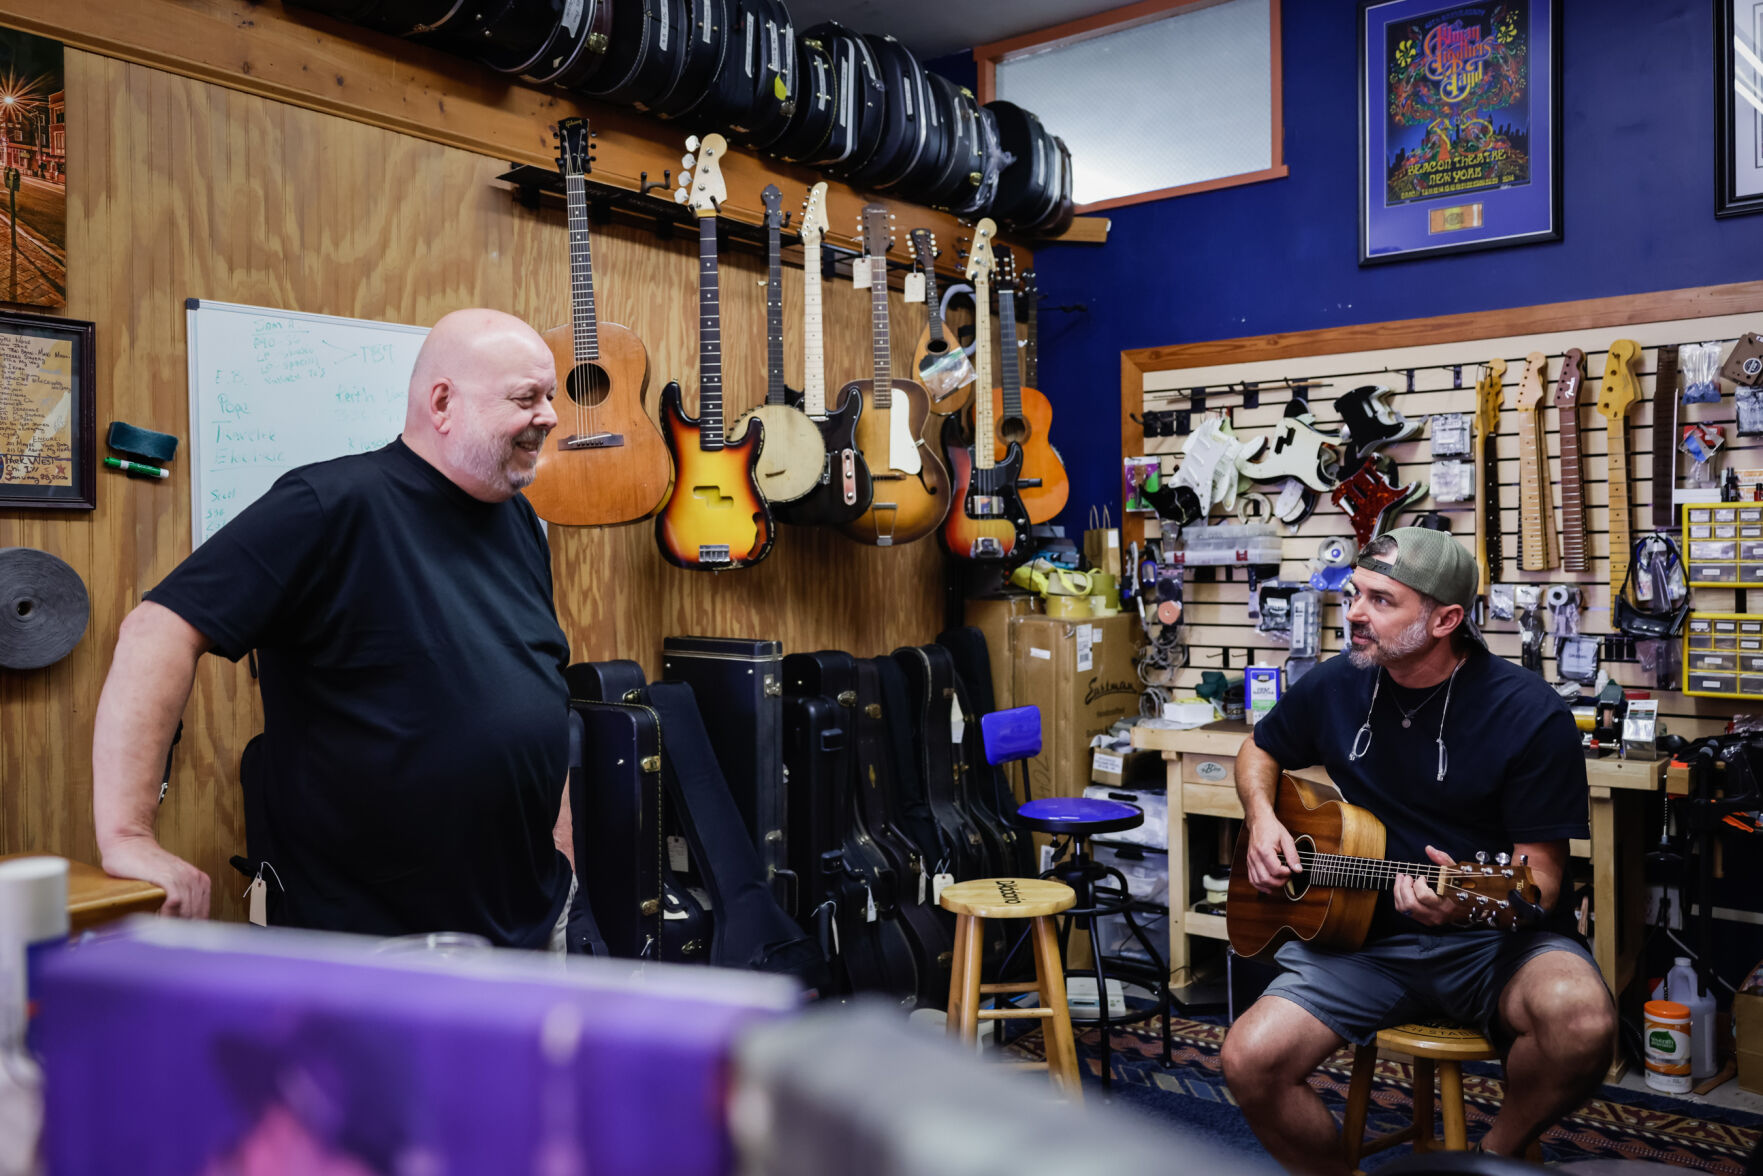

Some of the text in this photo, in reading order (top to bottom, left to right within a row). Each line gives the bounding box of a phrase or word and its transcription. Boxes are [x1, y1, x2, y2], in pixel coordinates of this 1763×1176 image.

[1440, 58, 1483, 102] Band
[1408, 149, 1507, 176] BEACON THEATRE
[1429, 166, 1482, 185] NEW YORK
[1084, 676, 1138, 706] Eastman
